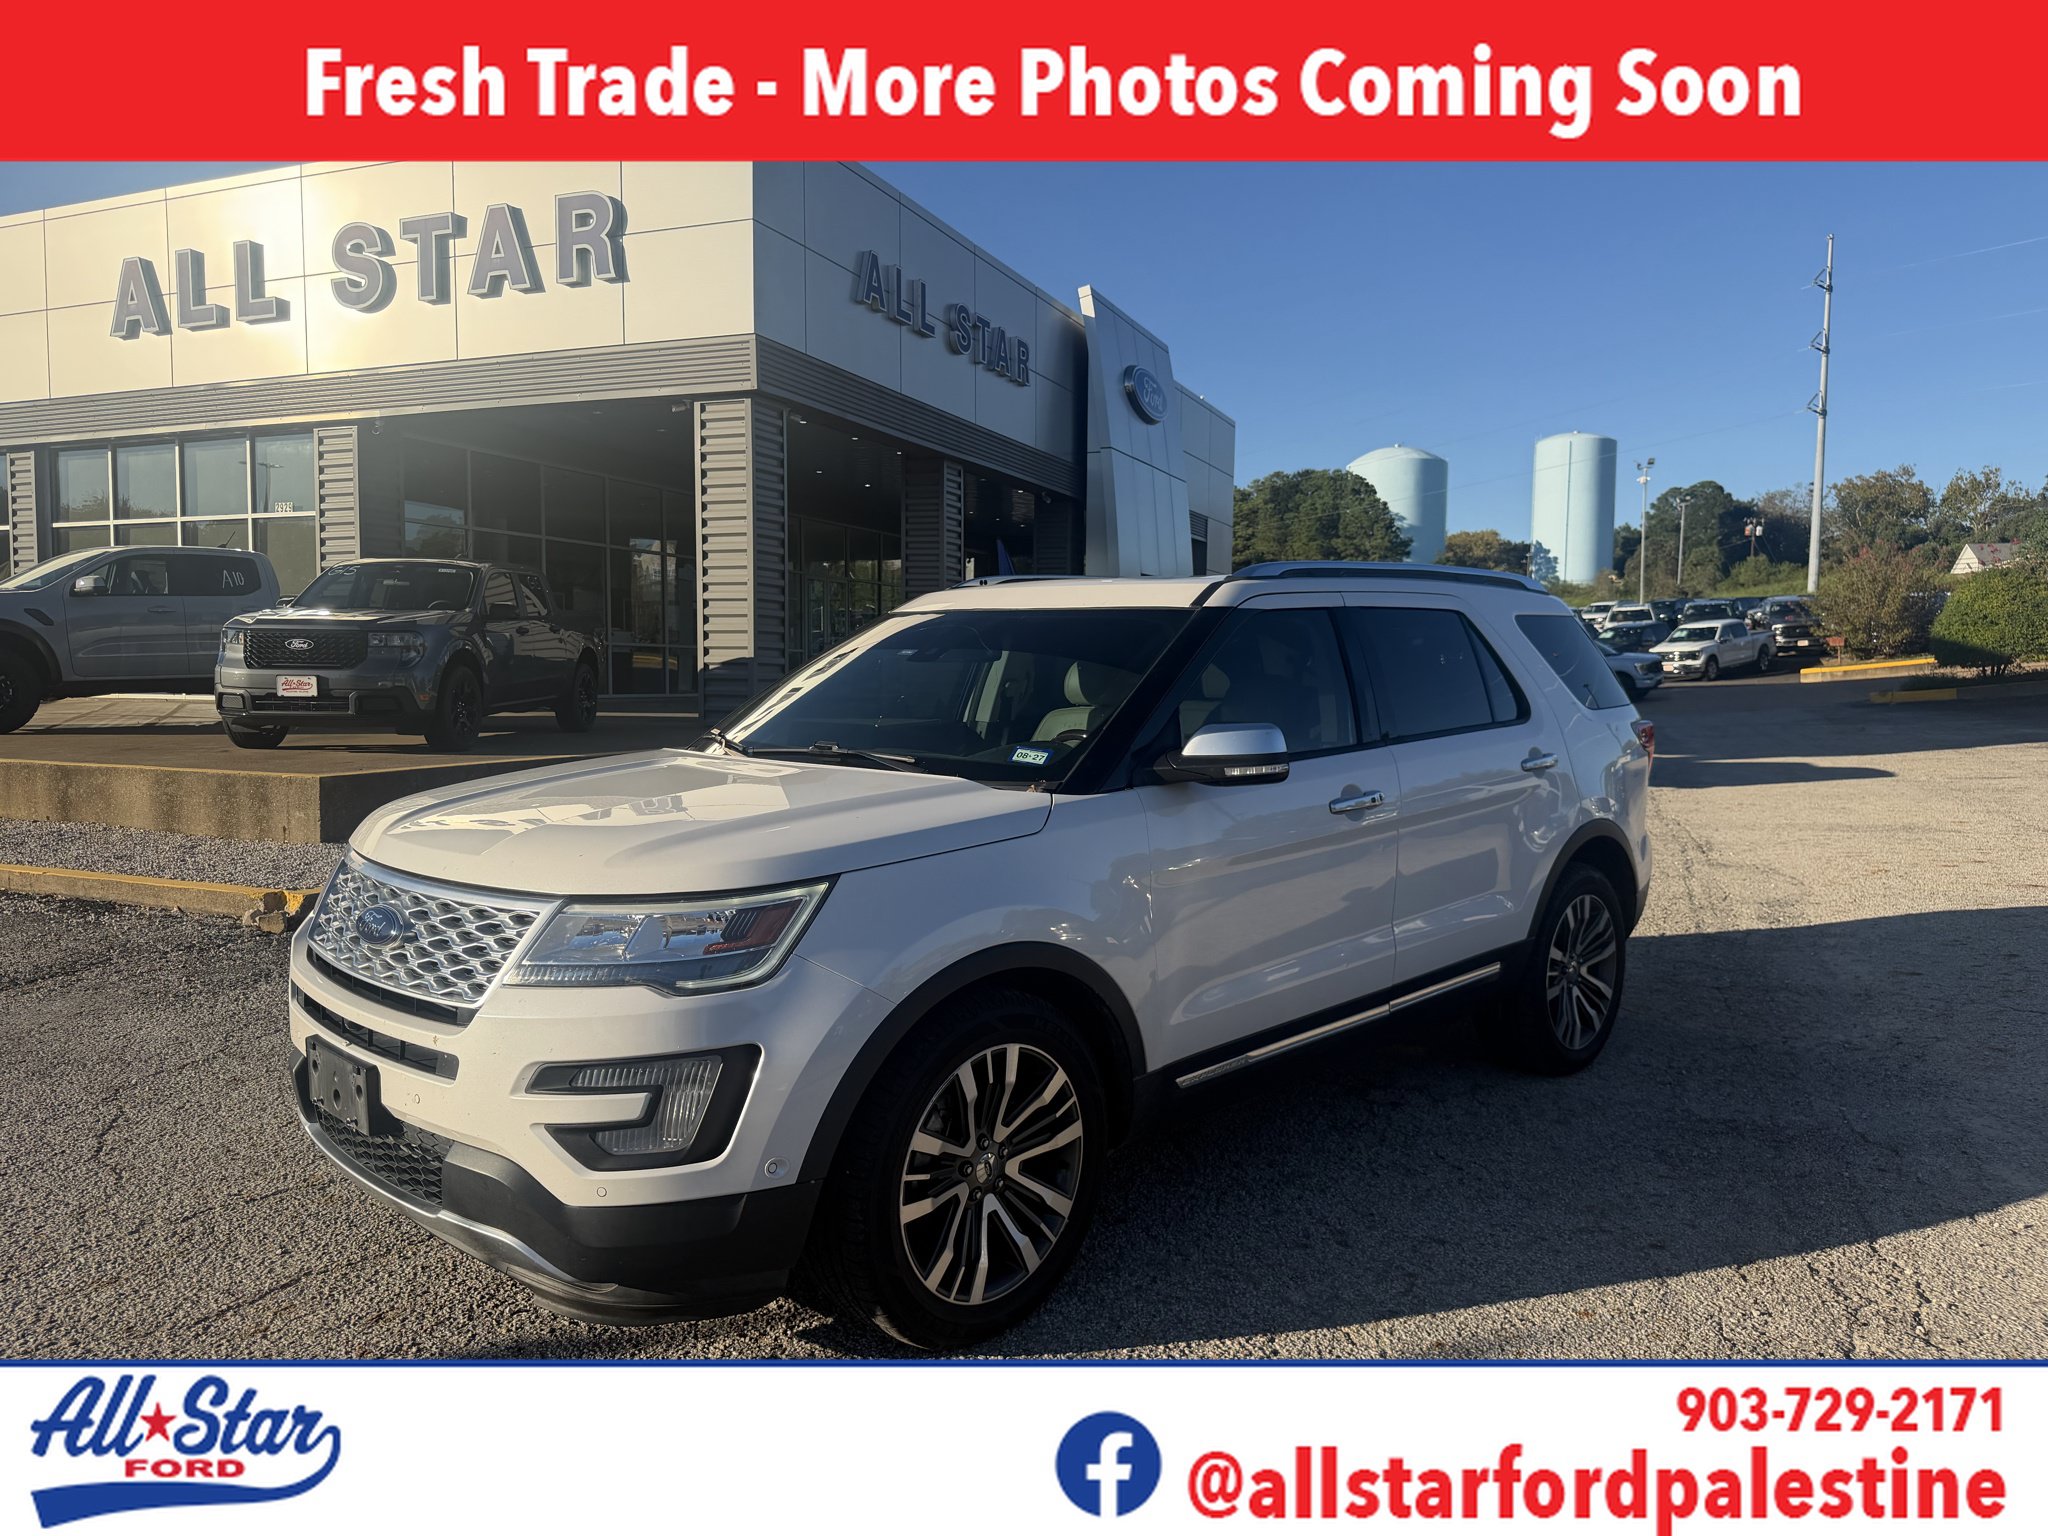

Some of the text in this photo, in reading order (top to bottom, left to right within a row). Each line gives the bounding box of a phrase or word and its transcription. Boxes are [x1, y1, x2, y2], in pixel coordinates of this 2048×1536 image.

[110, 190, 624, 340] ALL STAR
[858, 249, 1032, 387] ALL STAR
[222, 569, 245, 589] A10
[359, 910, 387, 937] Ford
